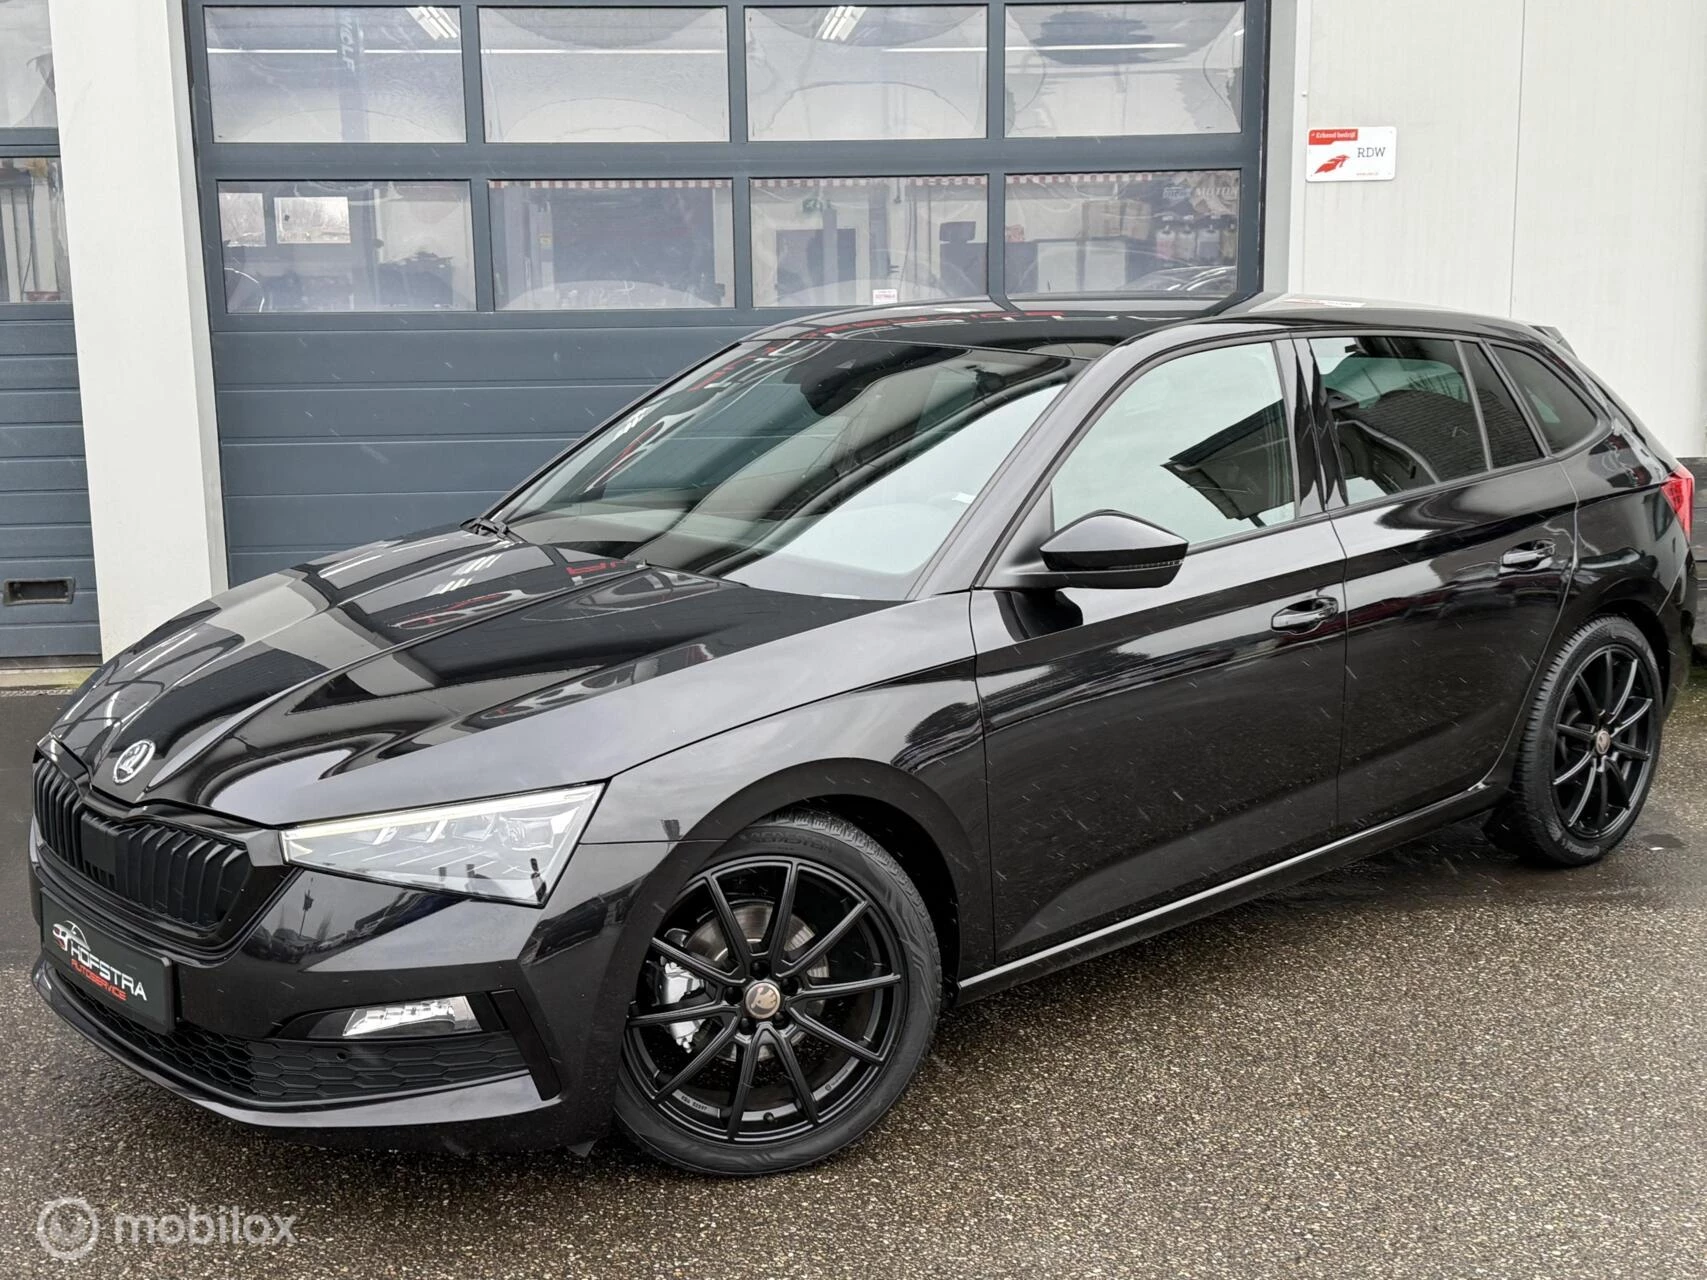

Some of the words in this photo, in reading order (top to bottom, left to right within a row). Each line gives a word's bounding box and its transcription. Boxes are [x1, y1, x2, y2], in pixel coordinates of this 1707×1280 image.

[1357, 147, 1386, 158] RDW
[70, 940, 148, 1001] HOFSTRA
[70, 958, 127, 1001] AUTOSERVICE
